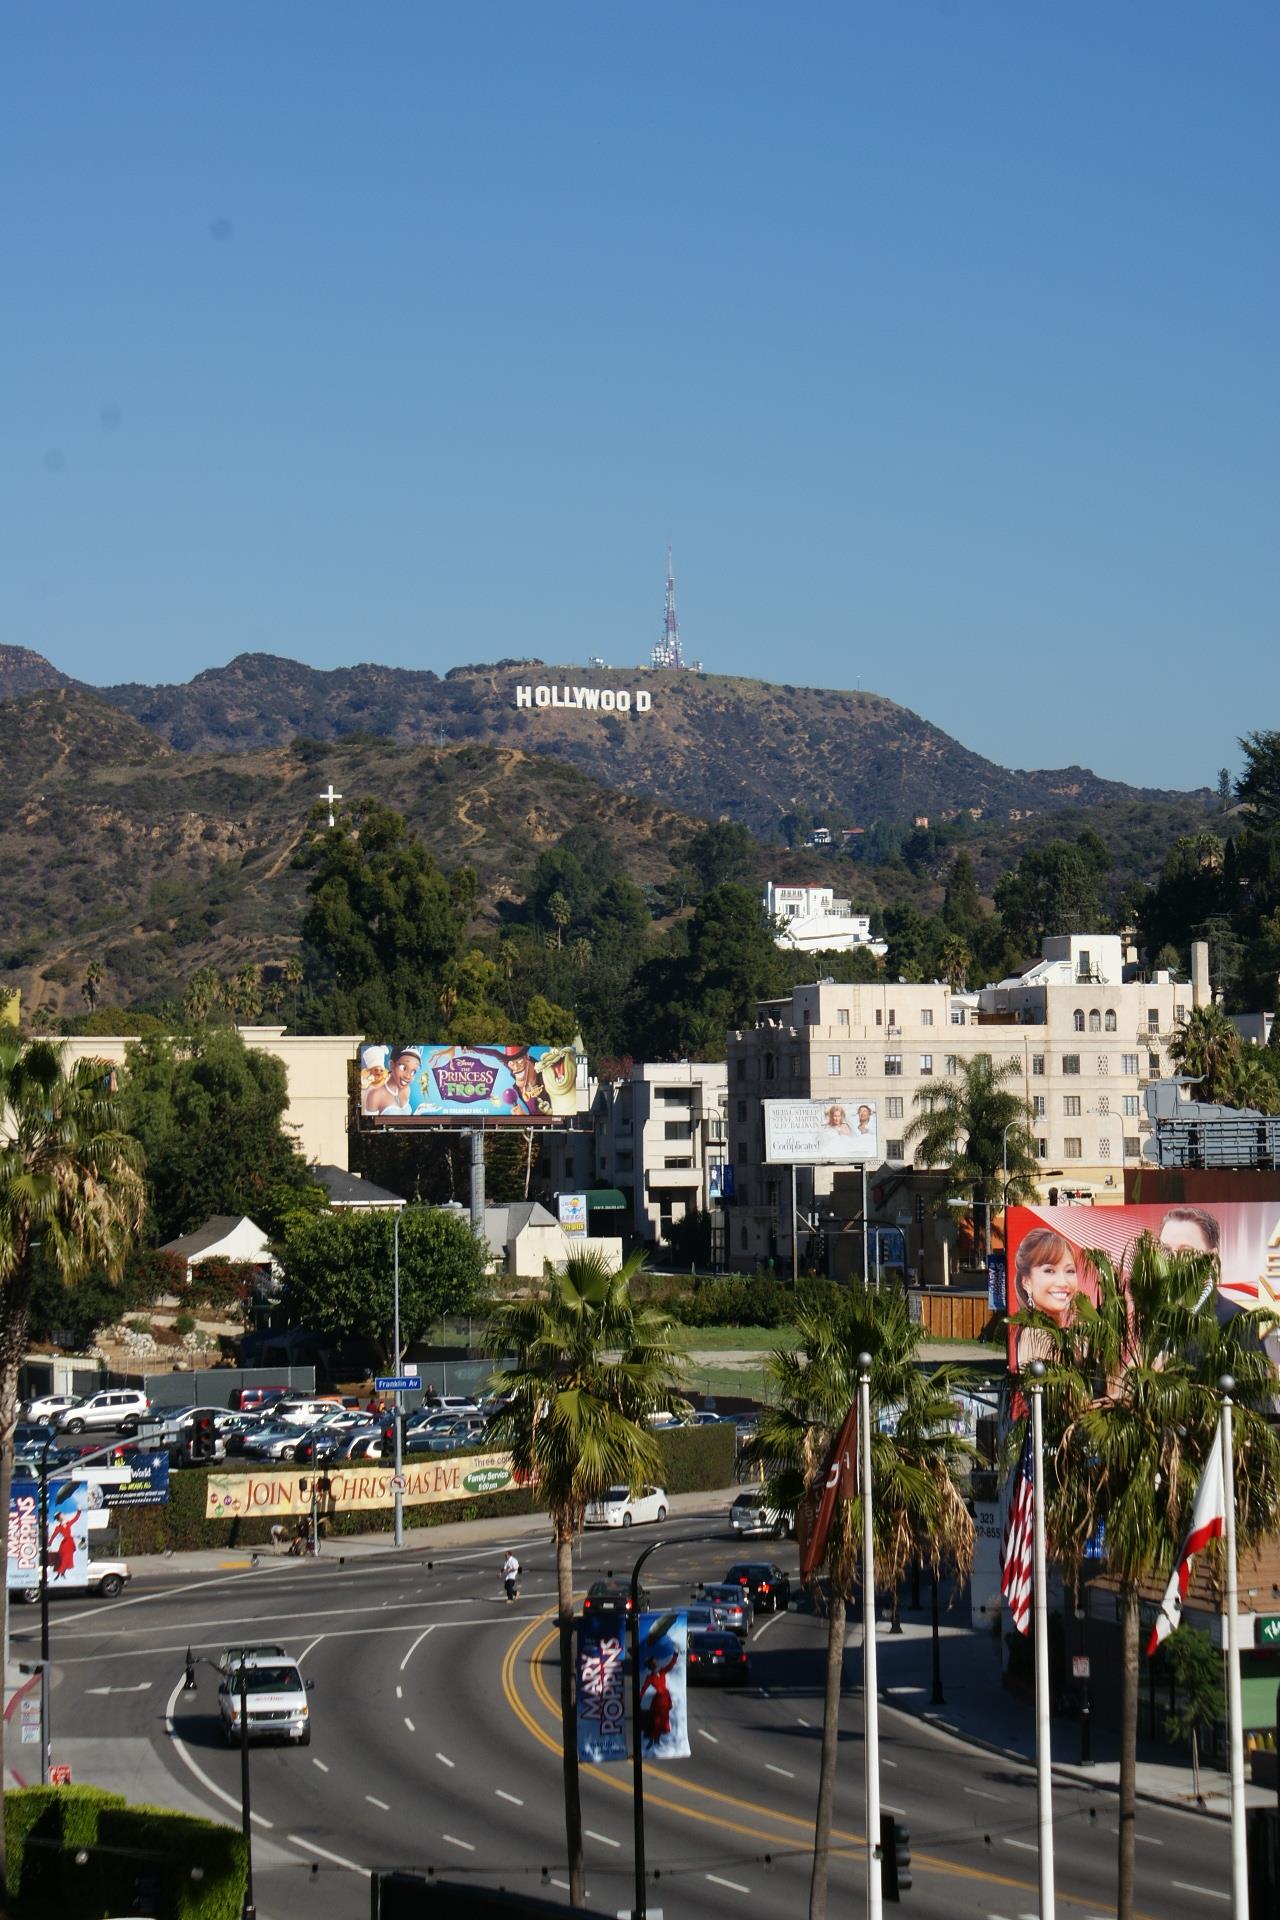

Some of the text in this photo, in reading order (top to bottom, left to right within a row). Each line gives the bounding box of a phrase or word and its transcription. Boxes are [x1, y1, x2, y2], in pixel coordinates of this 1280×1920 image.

[516, 685, 651, 712] HOLLYWOOD
[438, 1070, 494, 1088] PRINCESS
[447, 1083, 490, 1097] FROG
[772, 1141, 820, 1152] Complicated
[378, 1380, 407, 1388] Franklin
[474, 1457, 495, 1467] Three
[131, 1467, 151, 1478] World
[467, 1472, 488, 1484] Family
[487, 1470, 509, 1481] Service
[244, 1479, 293, 1513] JOIN
[433, 1466, 460, 1492] EVE
[17, 1496, 38, 1569] POPPINS
[580, 1654, 602, 1719] MARY
[600, 1639, 625, 1736] POPPINS
